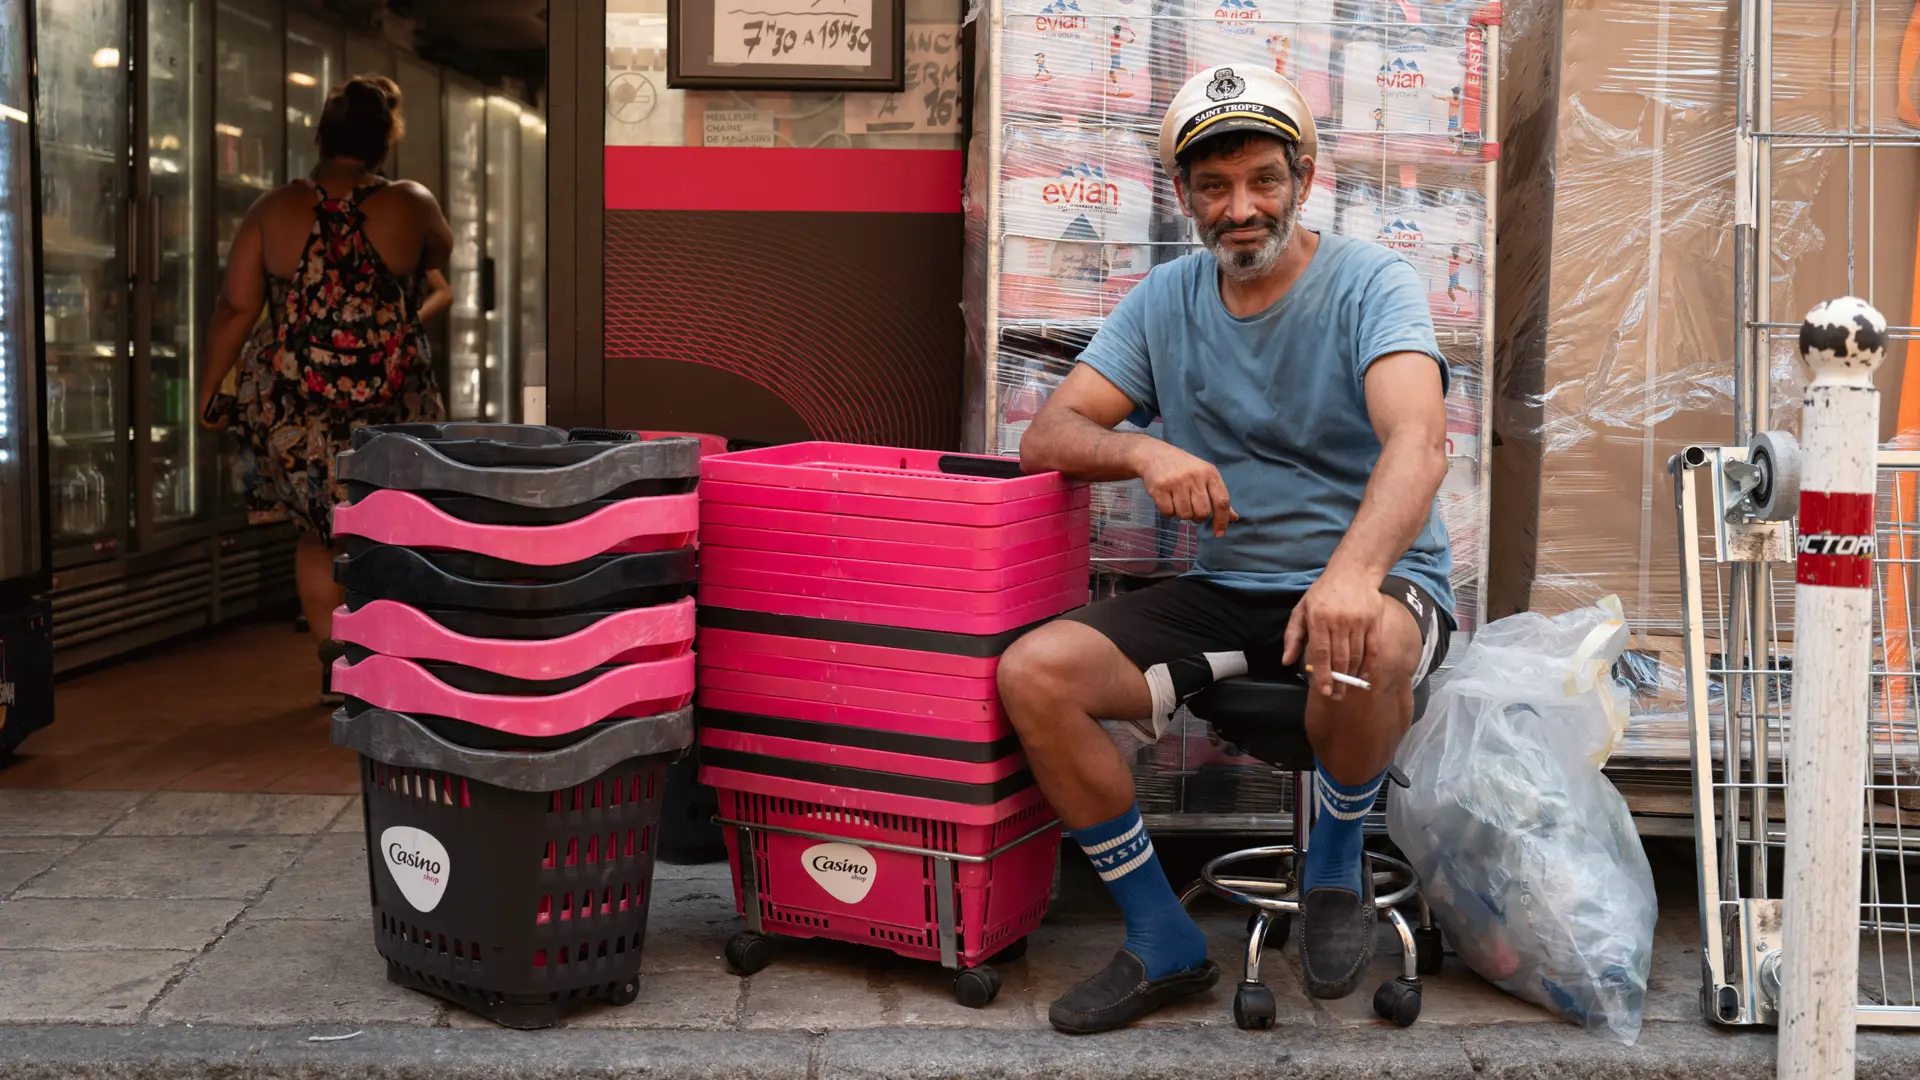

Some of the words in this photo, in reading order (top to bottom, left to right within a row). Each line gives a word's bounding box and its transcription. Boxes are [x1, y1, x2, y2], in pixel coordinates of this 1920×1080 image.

[1036, 12, 1088, 31] evian
[1214, 8, 1262, 26] evian
[1375, 71, 1424, 89] evian
[706, 113, 758, 121] MEILLEURE
[1195, 107, 1222, 124] SAINT
[1224, 104, 1264, 113] TROPEZ
[706, 122, 743, 132] CHAÎNE
[706, 135, 720, 143] DE
[1042, 178, 1119, 205] evian
[389, 843, 441, 875] Casino
[812, 855, 868, 875] Casino
[423, 872, 440, 886] shop
[851, 874, 867, 883] shop
